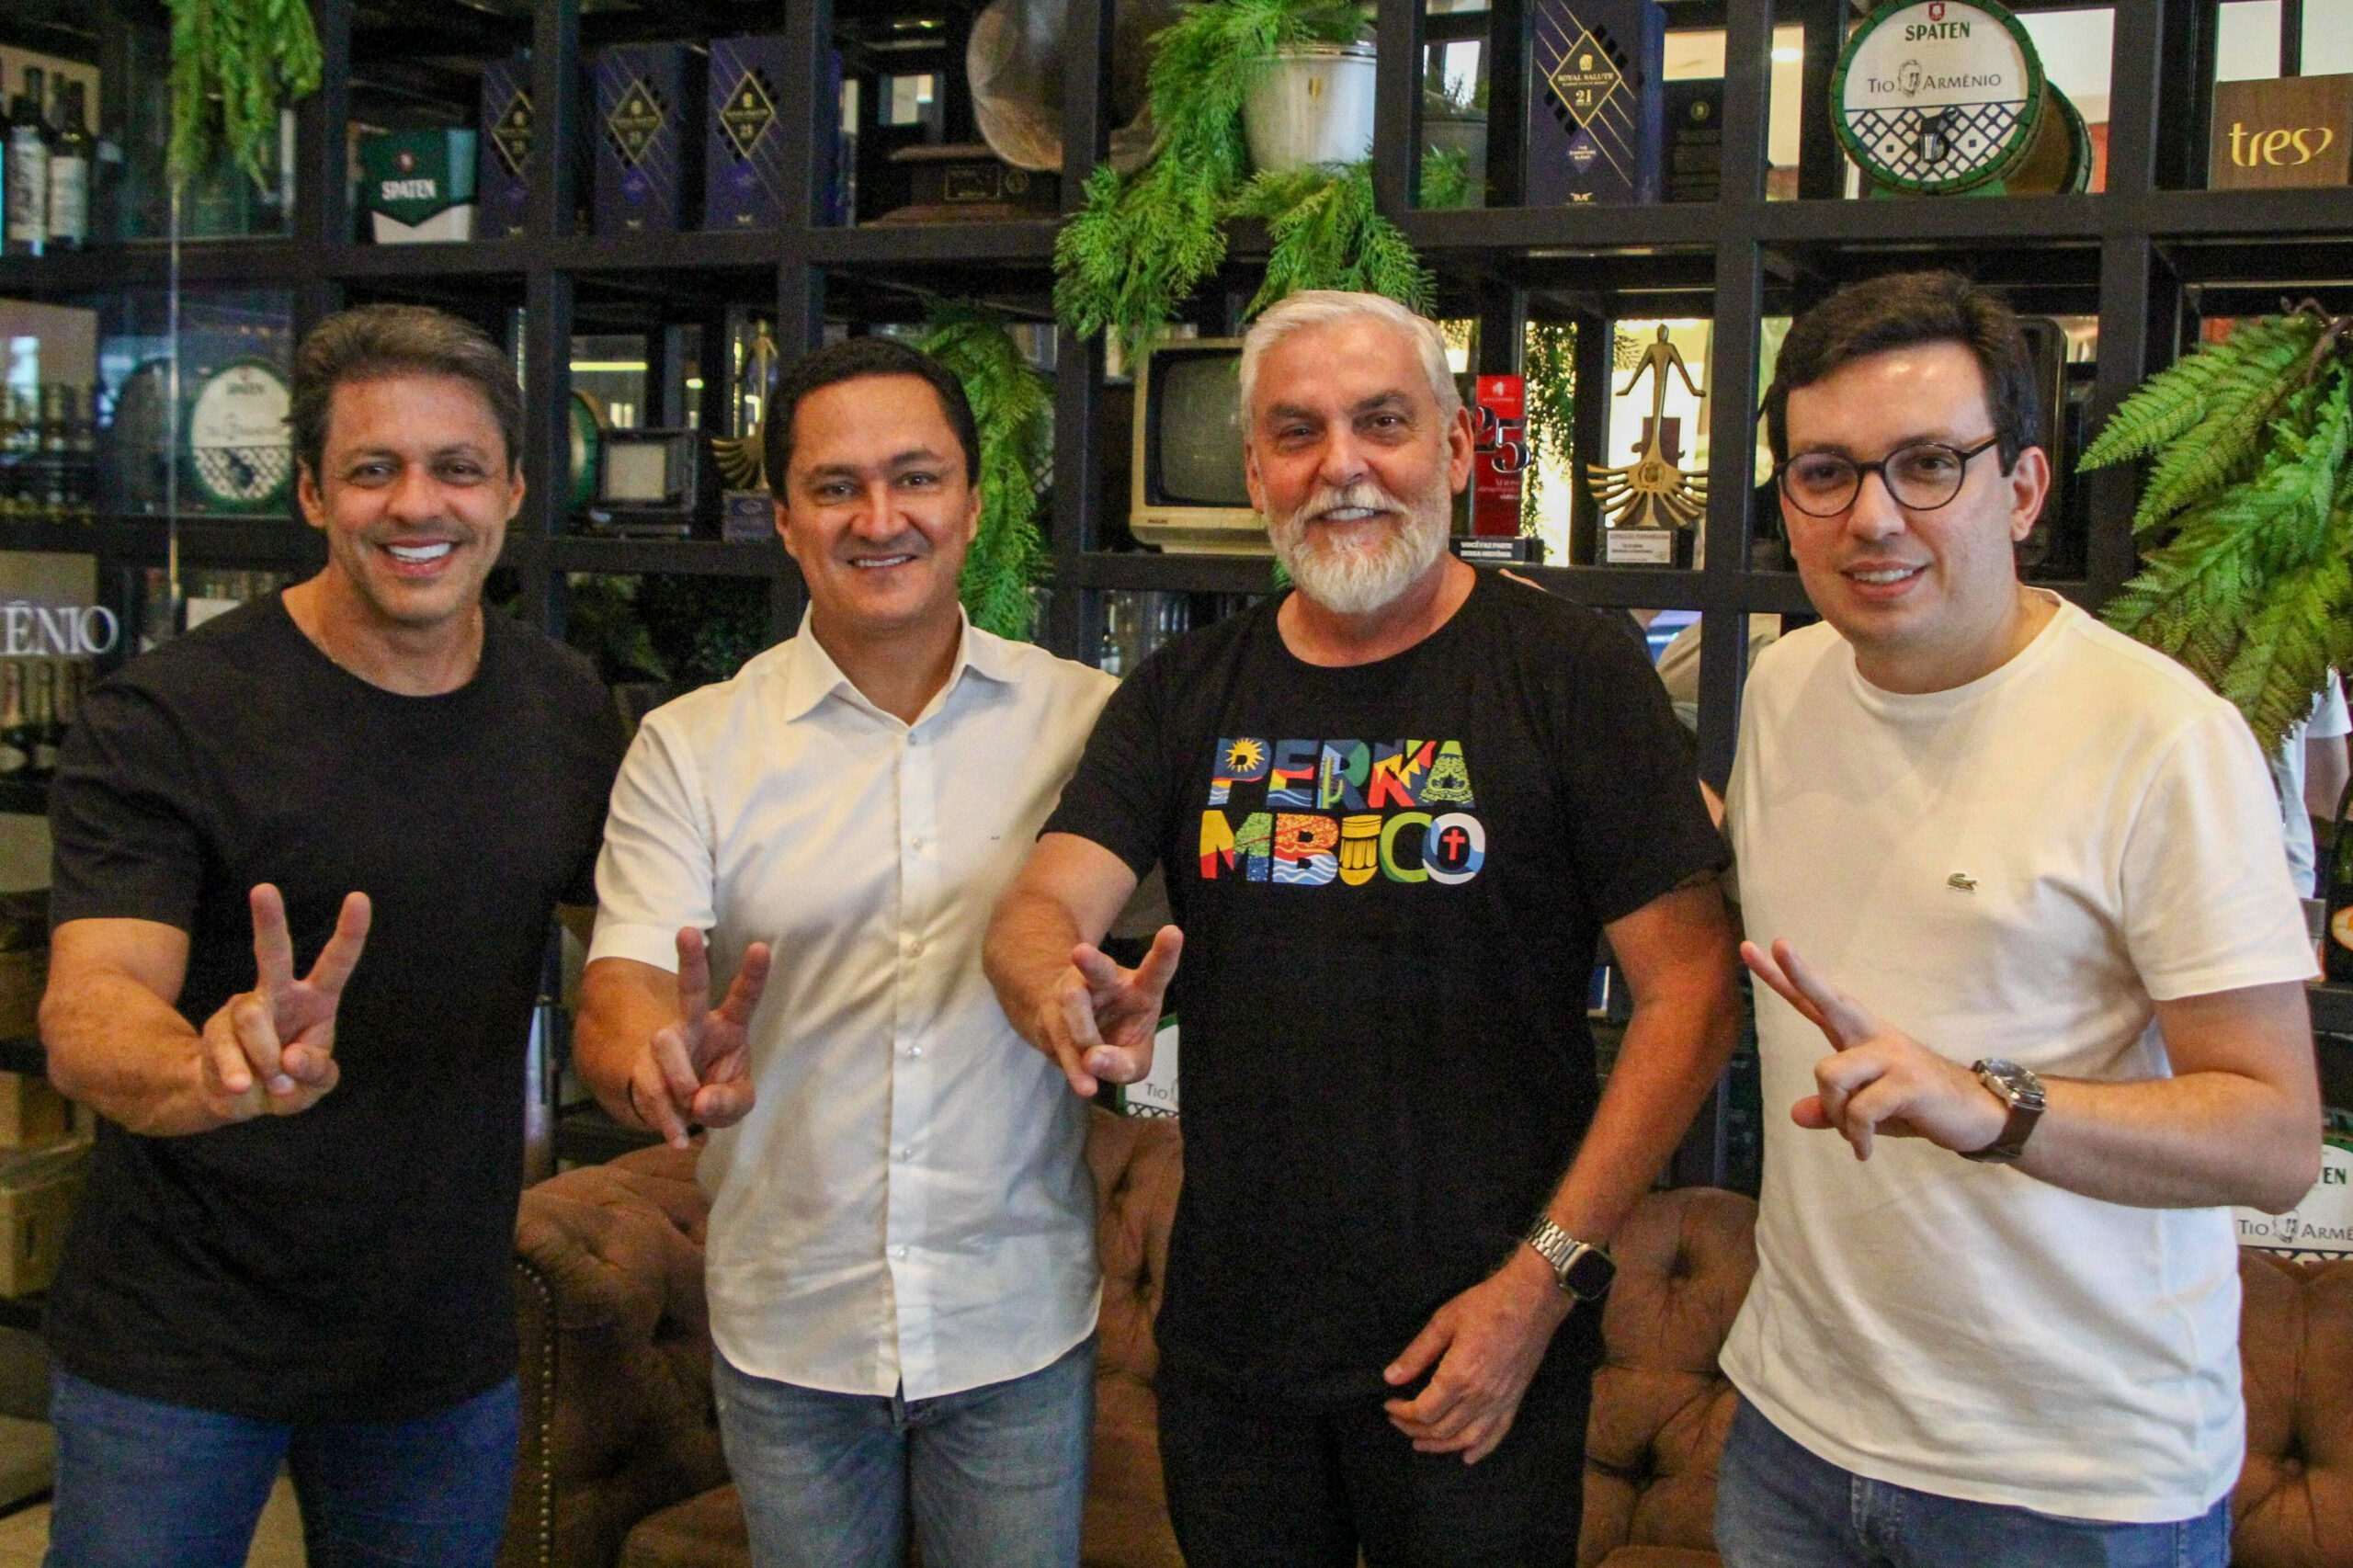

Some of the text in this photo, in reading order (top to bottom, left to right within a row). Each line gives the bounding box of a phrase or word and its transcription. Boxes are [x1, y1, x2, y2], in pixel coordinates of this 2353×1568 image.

[1904, 21, 1971, 42] SPATEN
[1557, 72, 1614, 82] ROYAL SALUTE
[1574, 88, 1593, 105] 21
[2228, 121, 2333, 167] tres
[381, 178, 437, 200] SPATEN
[1206, 736, 1476, 810] PERNA
[1199, 810, 1487, 885] MBUCO
